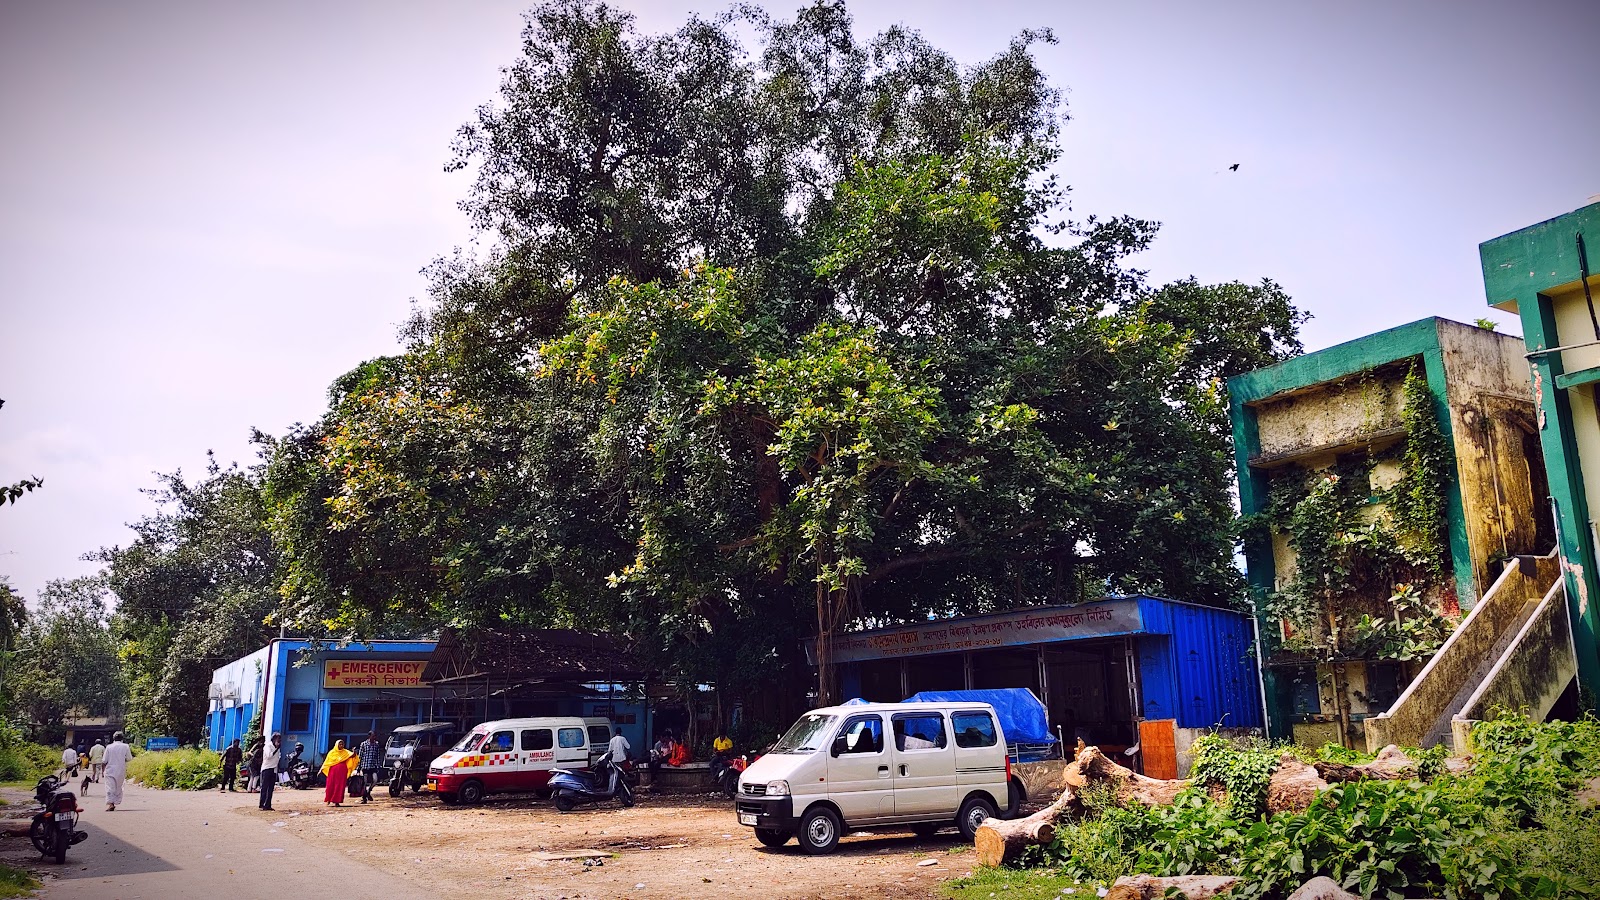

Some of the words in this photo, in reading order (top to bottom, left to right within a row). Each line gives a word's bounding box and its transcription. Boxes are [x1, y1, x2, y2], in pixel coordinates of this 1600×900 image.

[1086, 606, 1114, 621] নির্মিত
[342, 663, 420, 674] EMERGENCY
[341, 674, 379, 686] জরুরী
[383, 674, 420, 686] বিভাগ
[529, 751, 554, 759] AMBULANCE
